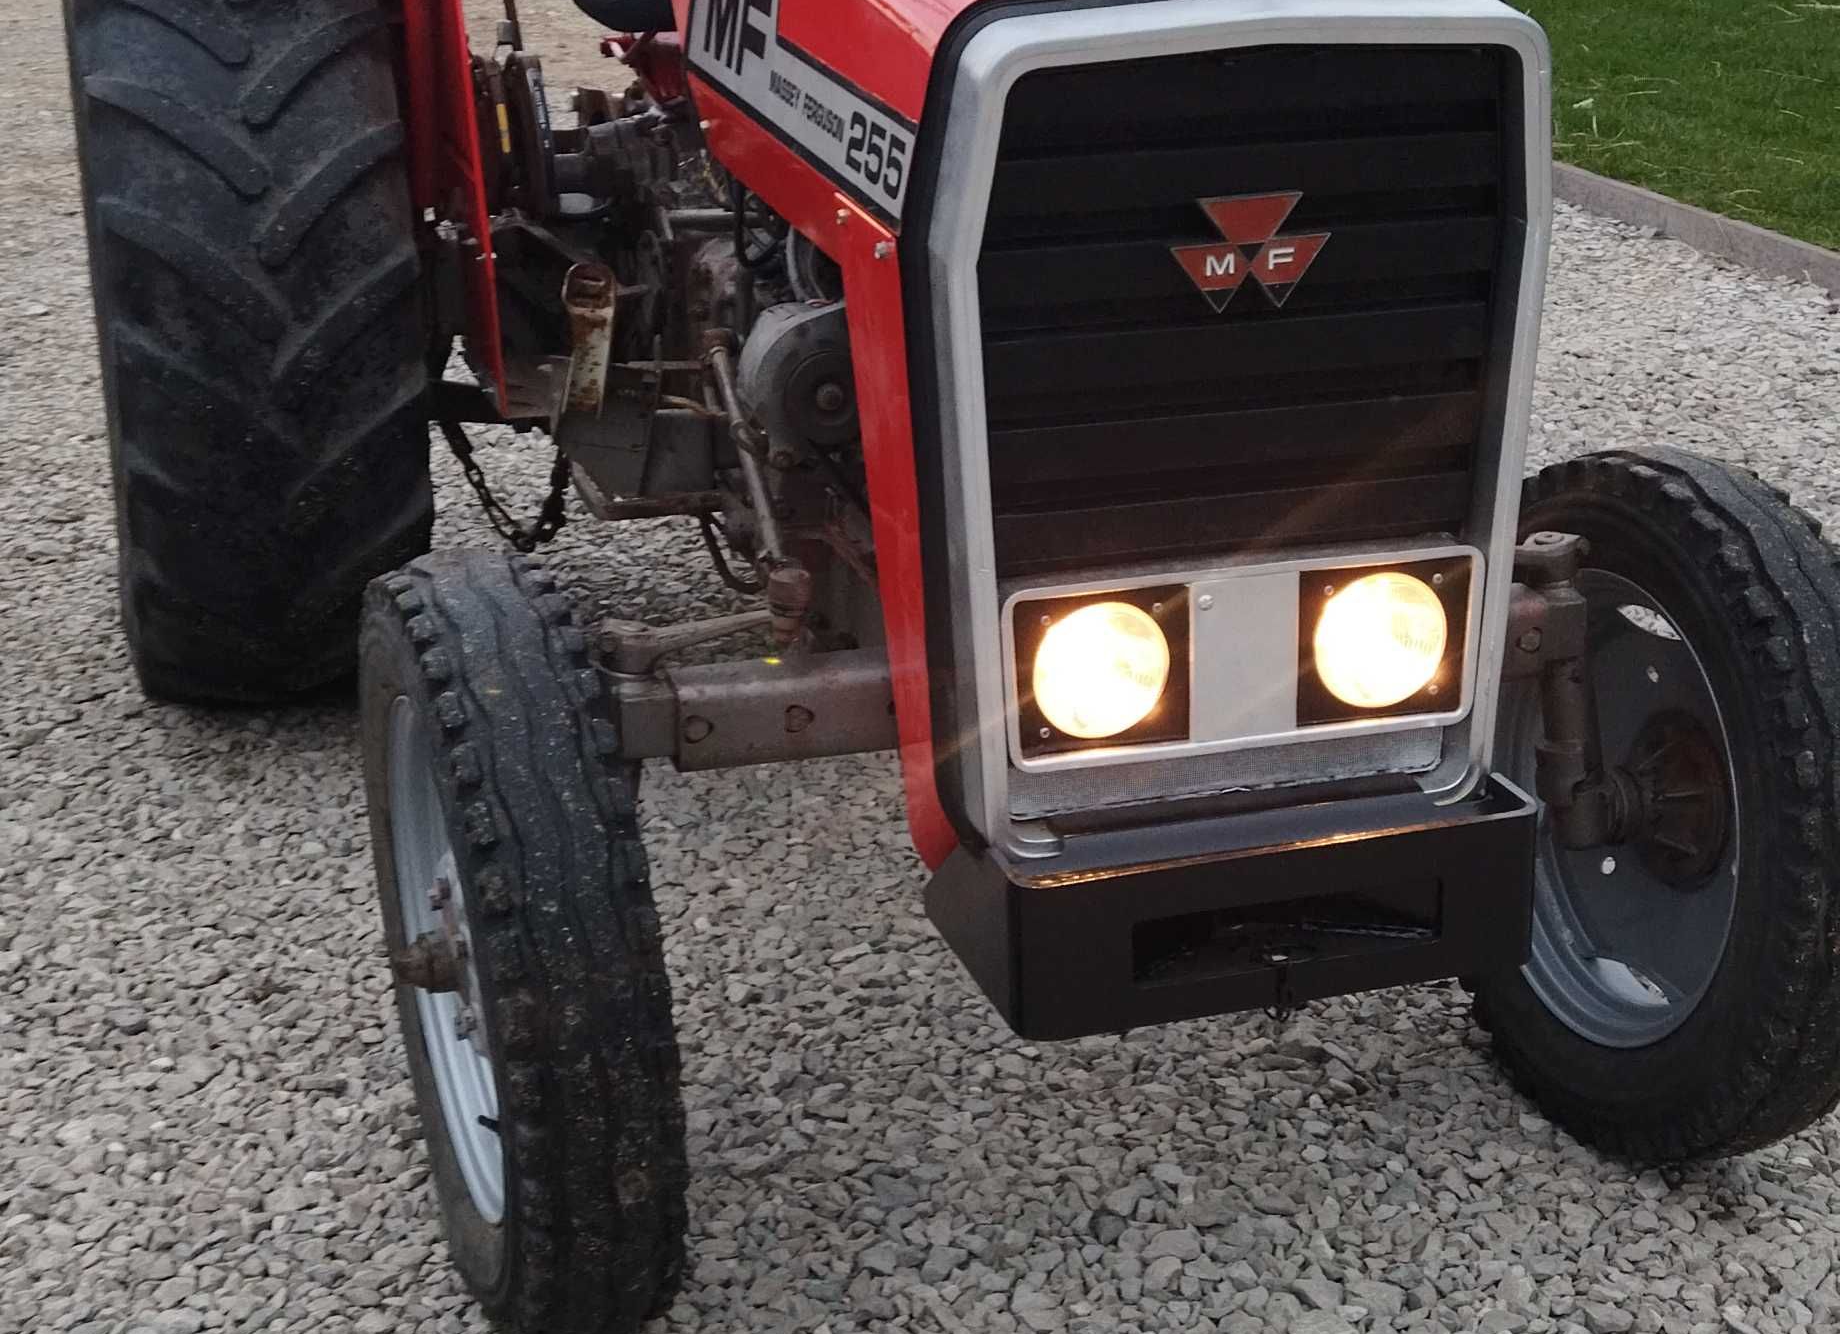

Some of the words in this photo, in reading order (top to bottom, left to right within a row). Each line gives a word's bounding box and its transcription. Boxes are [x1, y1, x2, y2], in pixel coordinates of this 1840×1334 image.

[768, 69, 801, 109] MASSEY
[802, 92, 846, 143] FERGUSON
[845, 110, 906, 200] 255
